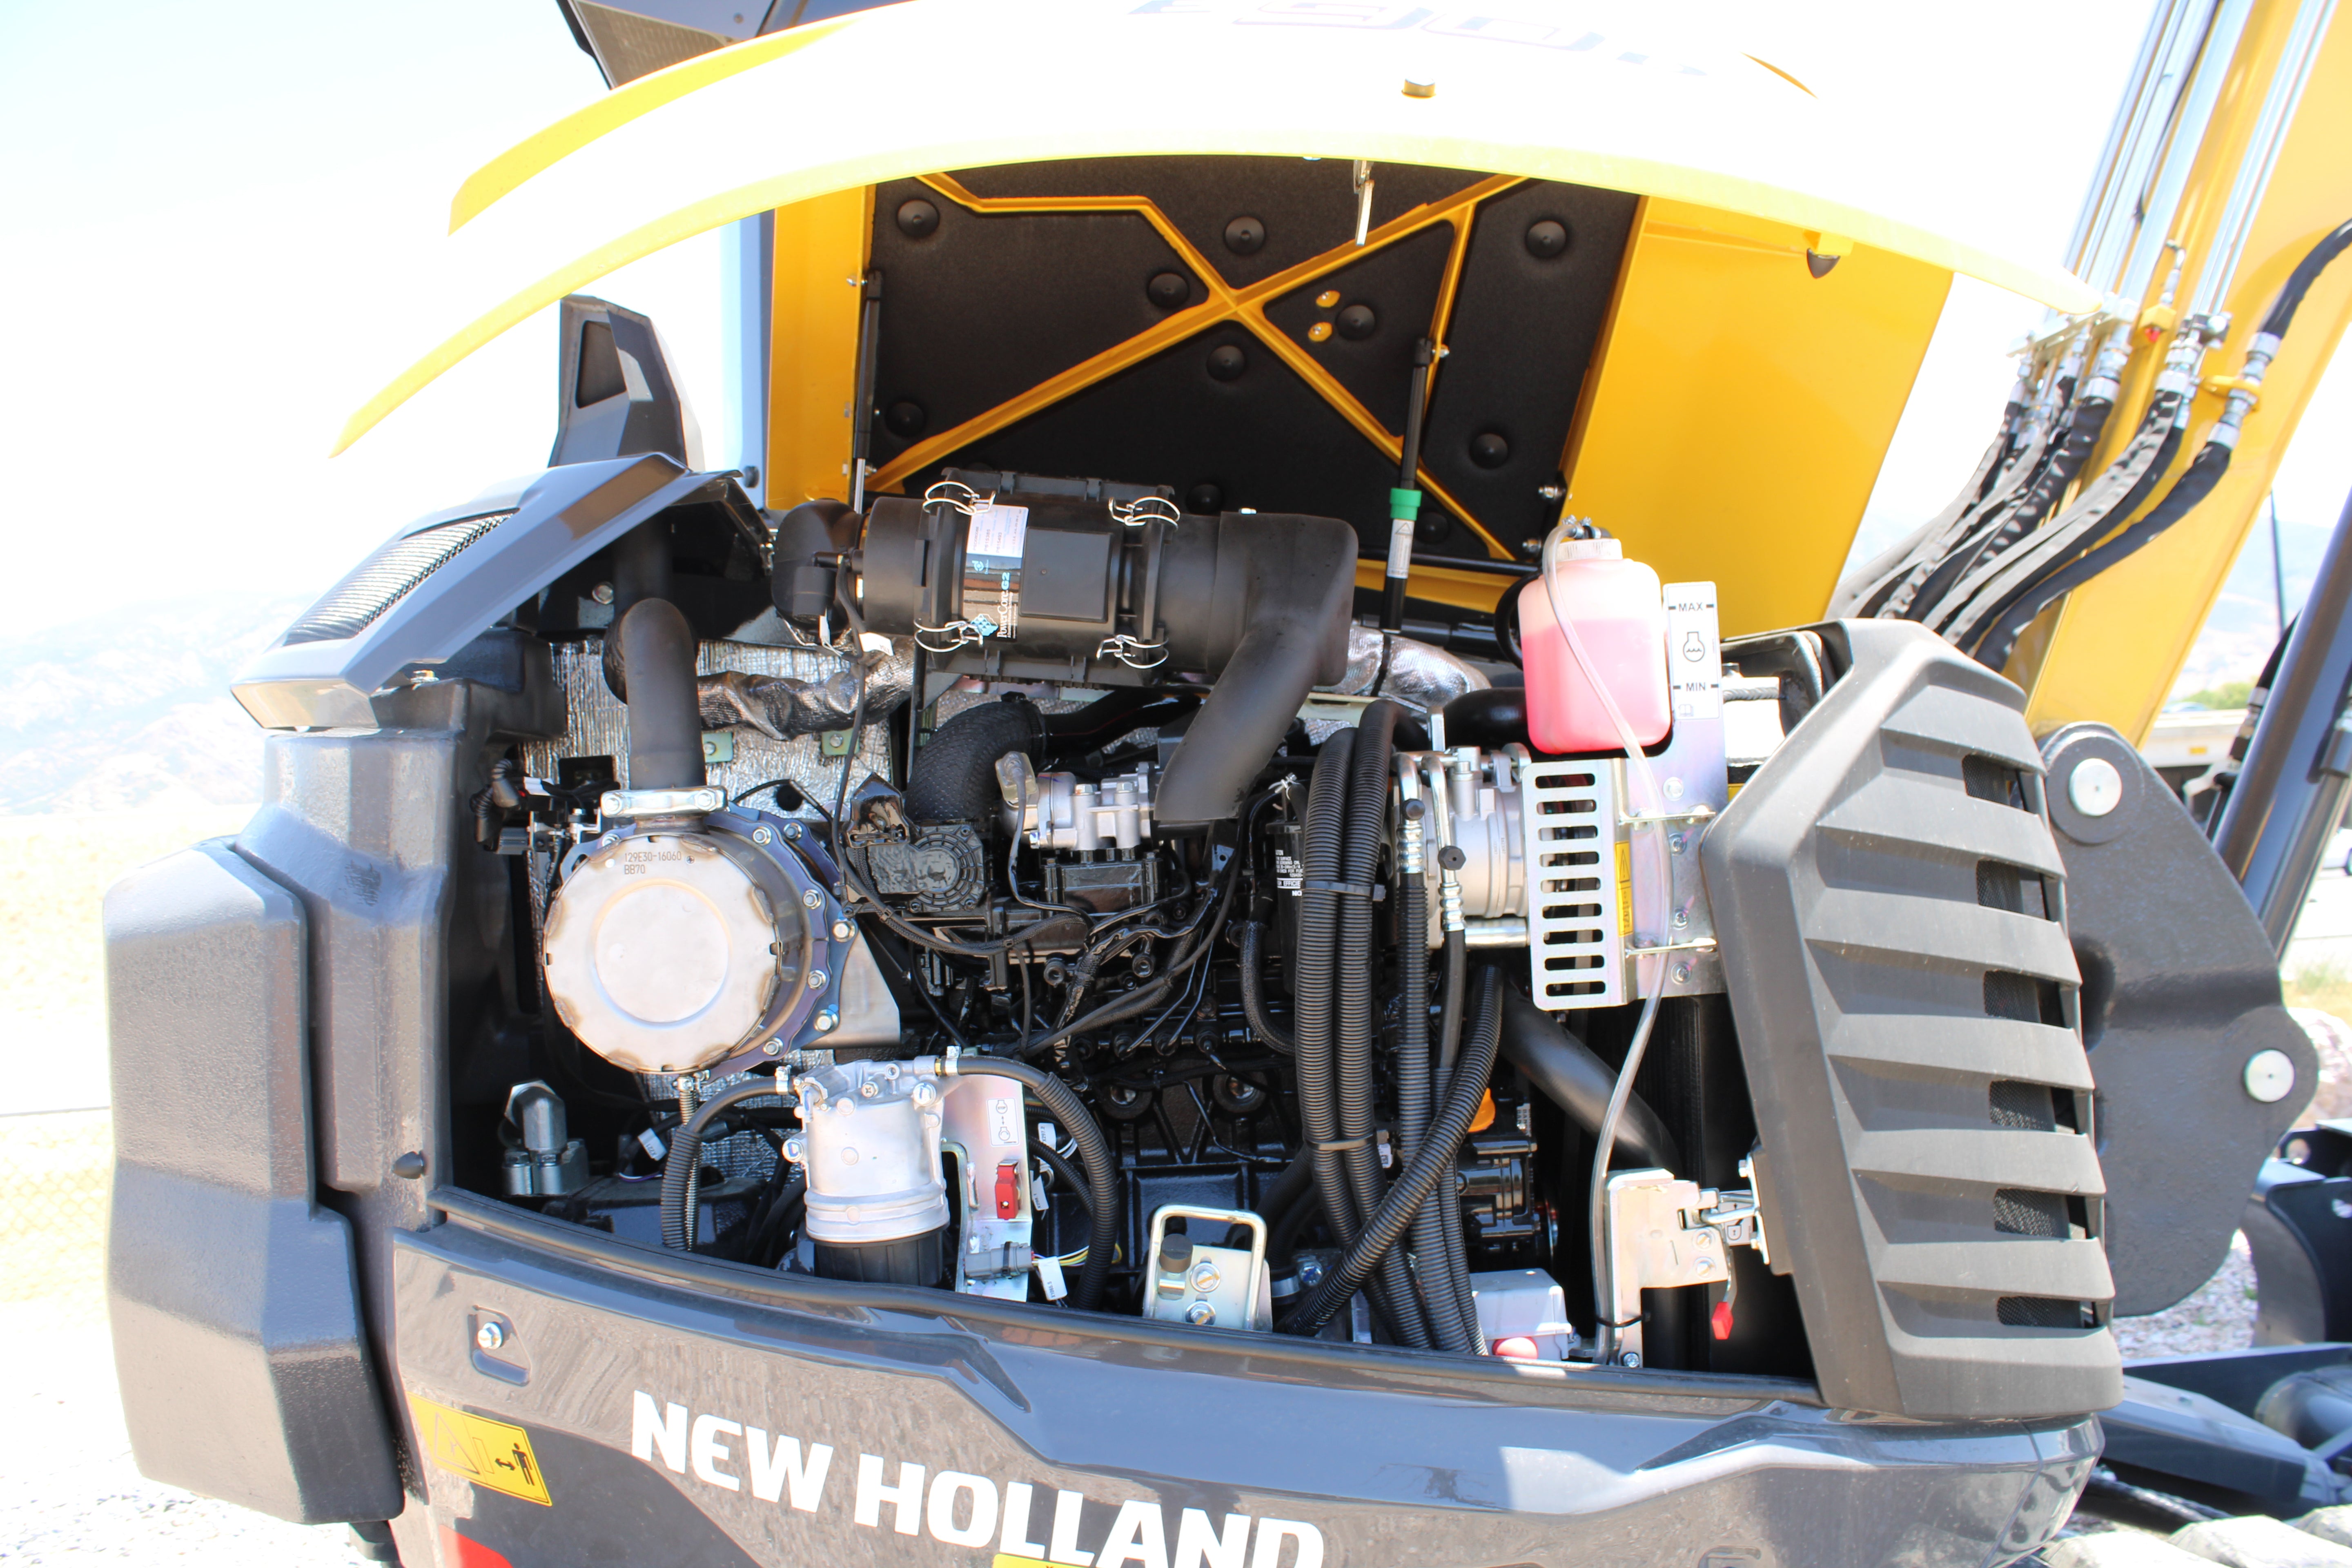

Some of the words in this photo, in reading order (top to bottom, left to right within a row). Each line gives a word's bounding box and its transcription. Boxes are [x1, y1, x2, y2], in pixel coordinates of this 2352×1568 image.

[1001, 572, 1010, 590] G2
[1679, 602, 1703, 612] MAX
[1686, 682, 1706, 691] MIN
[625, 851, 682, 862] 129E30-16060
[624, 864, 645, 874] BB70
[631, 1390, 833, 1512] NEW
[854, 1453, 1324, 1568] HOLLAND
